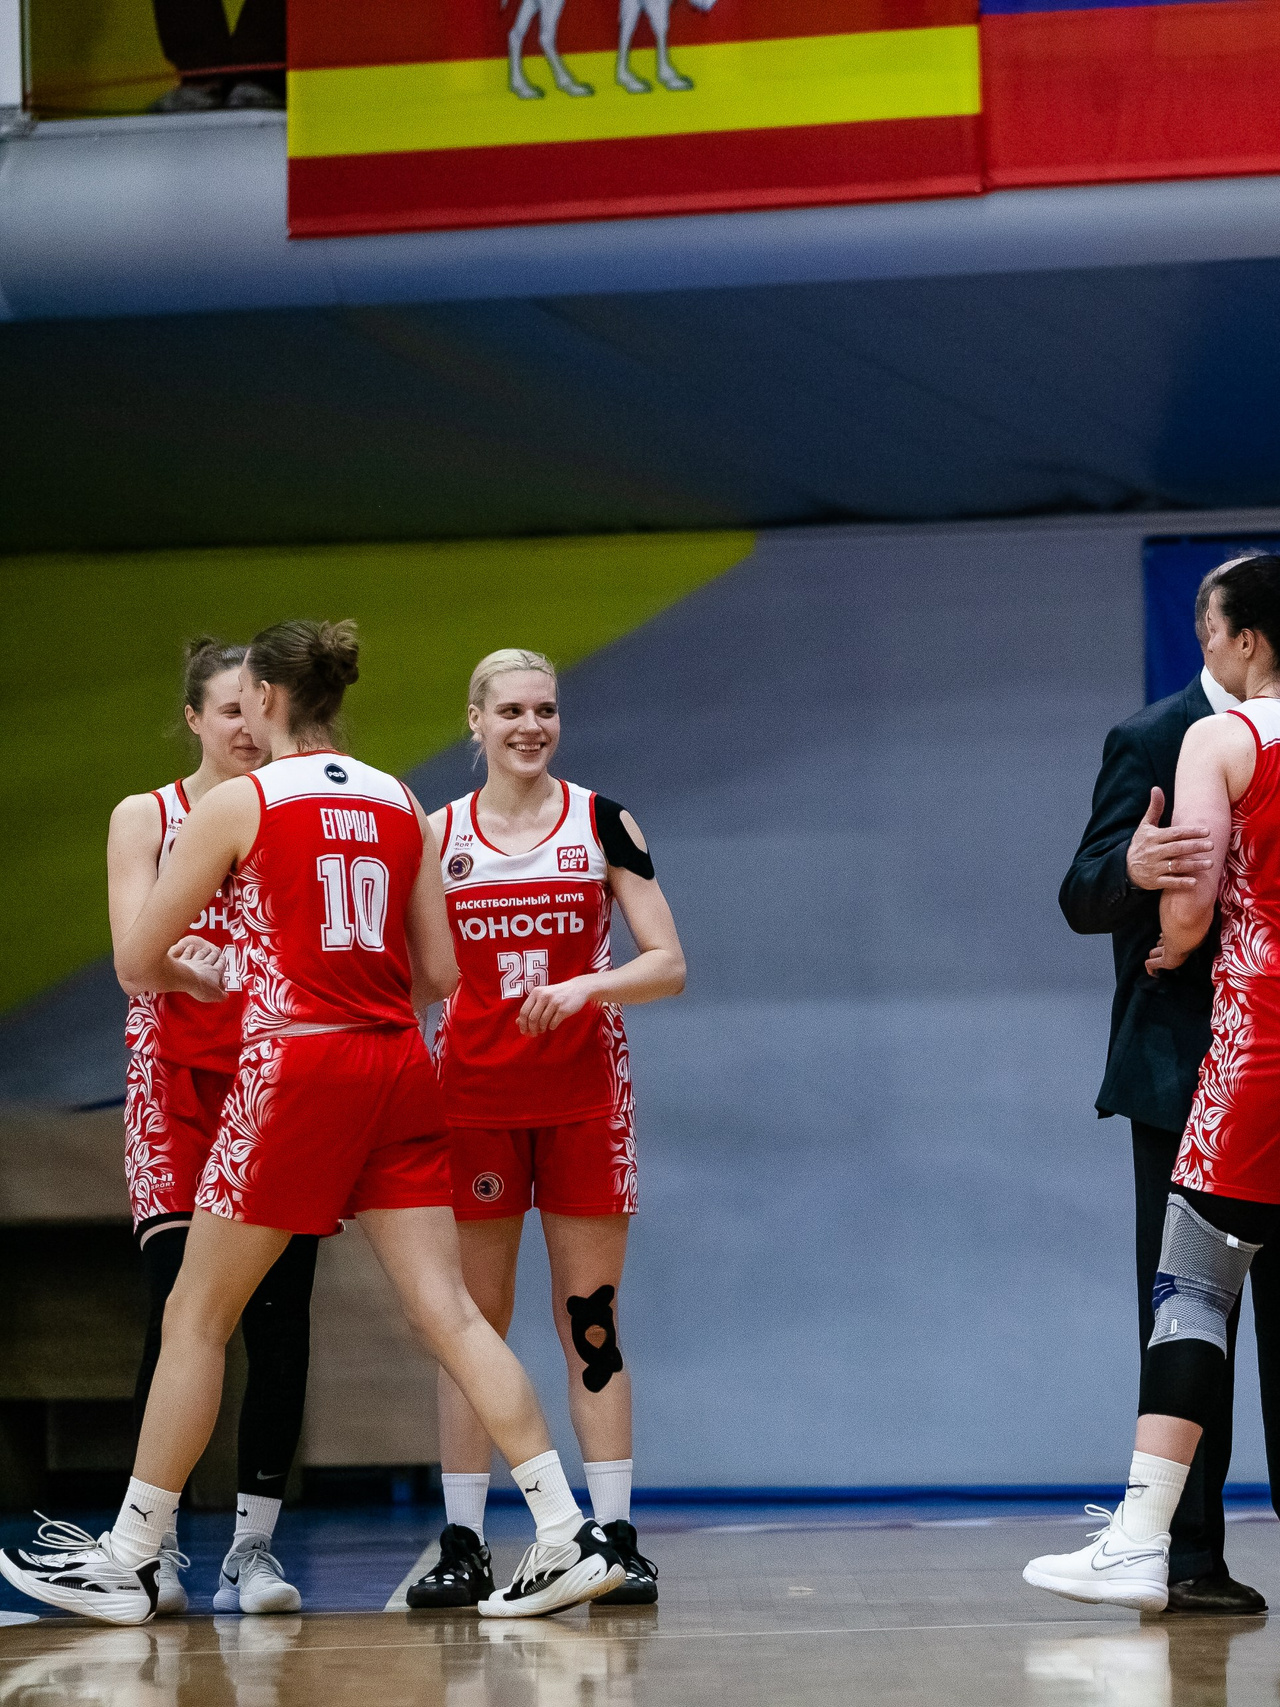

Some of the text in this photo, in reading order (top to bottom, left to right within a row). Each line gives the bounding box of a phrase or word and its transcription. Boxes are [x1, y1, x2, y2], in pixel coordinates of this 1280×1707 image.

[320, 807, 379, 844] ЕГОРОВА
[560, 847, 586, 859] FON
[561, 857, 587, 870] BET
[316, 853, 389, 952] 10
[455, 892, 585, 911] БАСКЕТБОЛЬНЫЙ КЛУБ
[457, 911, 585, 941] ЮНОСТЬ
[496, 948, 549, 1000] 25
